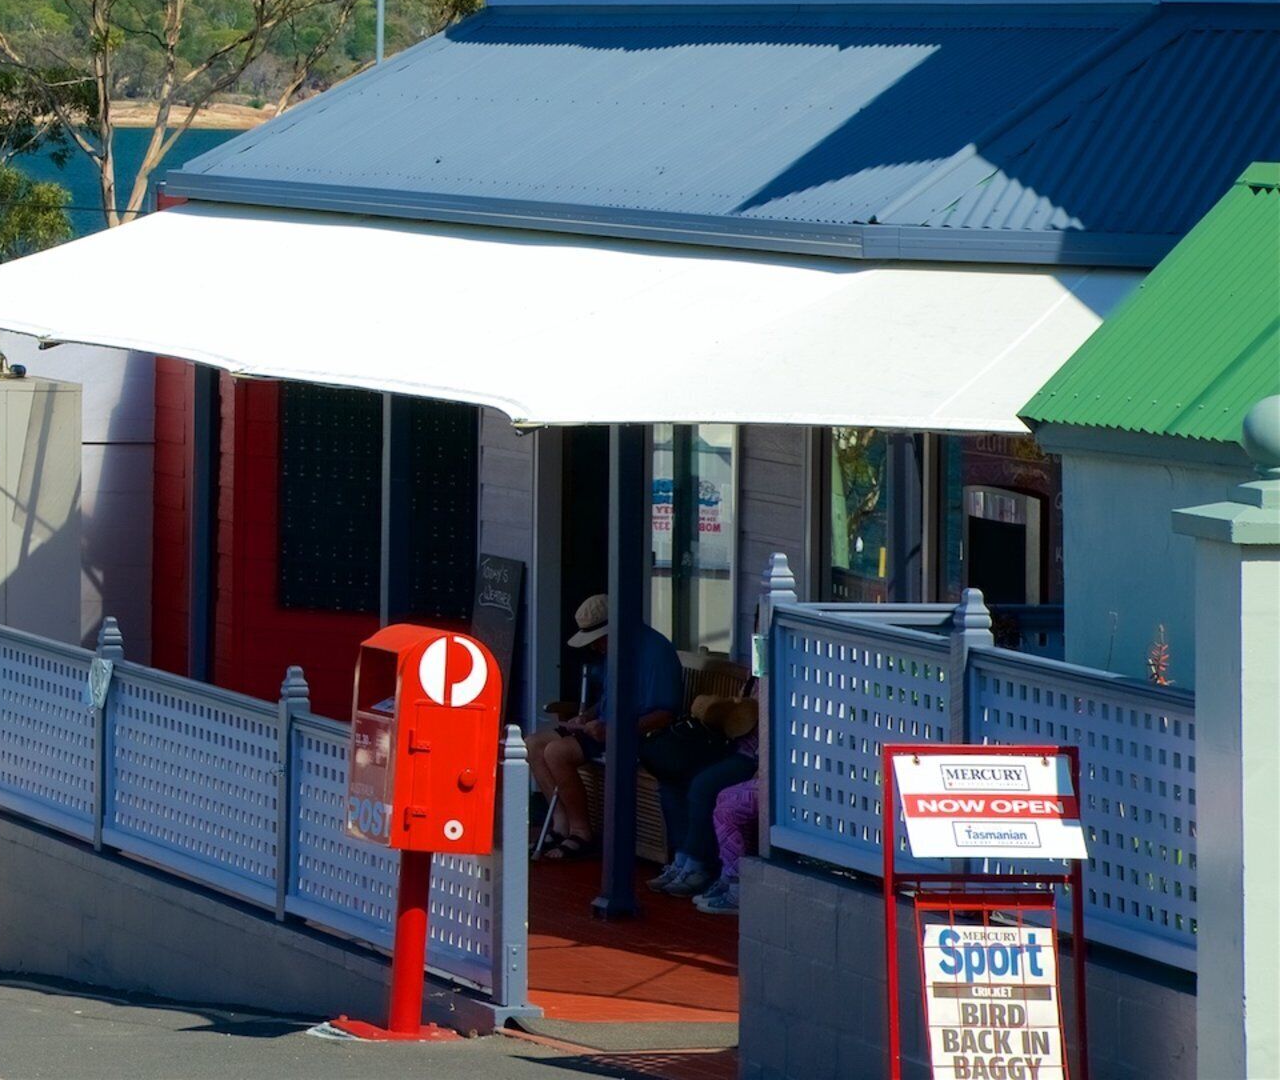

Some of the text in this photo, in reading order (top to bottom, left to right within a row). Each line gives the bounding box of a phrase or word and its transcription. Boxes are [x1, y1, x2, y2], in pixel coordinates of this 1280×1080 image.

[945, 768, 1023, 782] MERCURY
[917, 799, 1065, 814] NOW OPEN
[965, 828, 1028, 840] Tasmanian
[962, 931, 1017, 942] MERCURY
[938, 928, 1044, 983] Sport
[971, 986, 1013, 998] CRICKET
[961, 1003, 1026, 1029] BIRD
[942, 1029, 1050, 1055] BACK IN
[953, 1055, 1042, 1080] BAGGY
